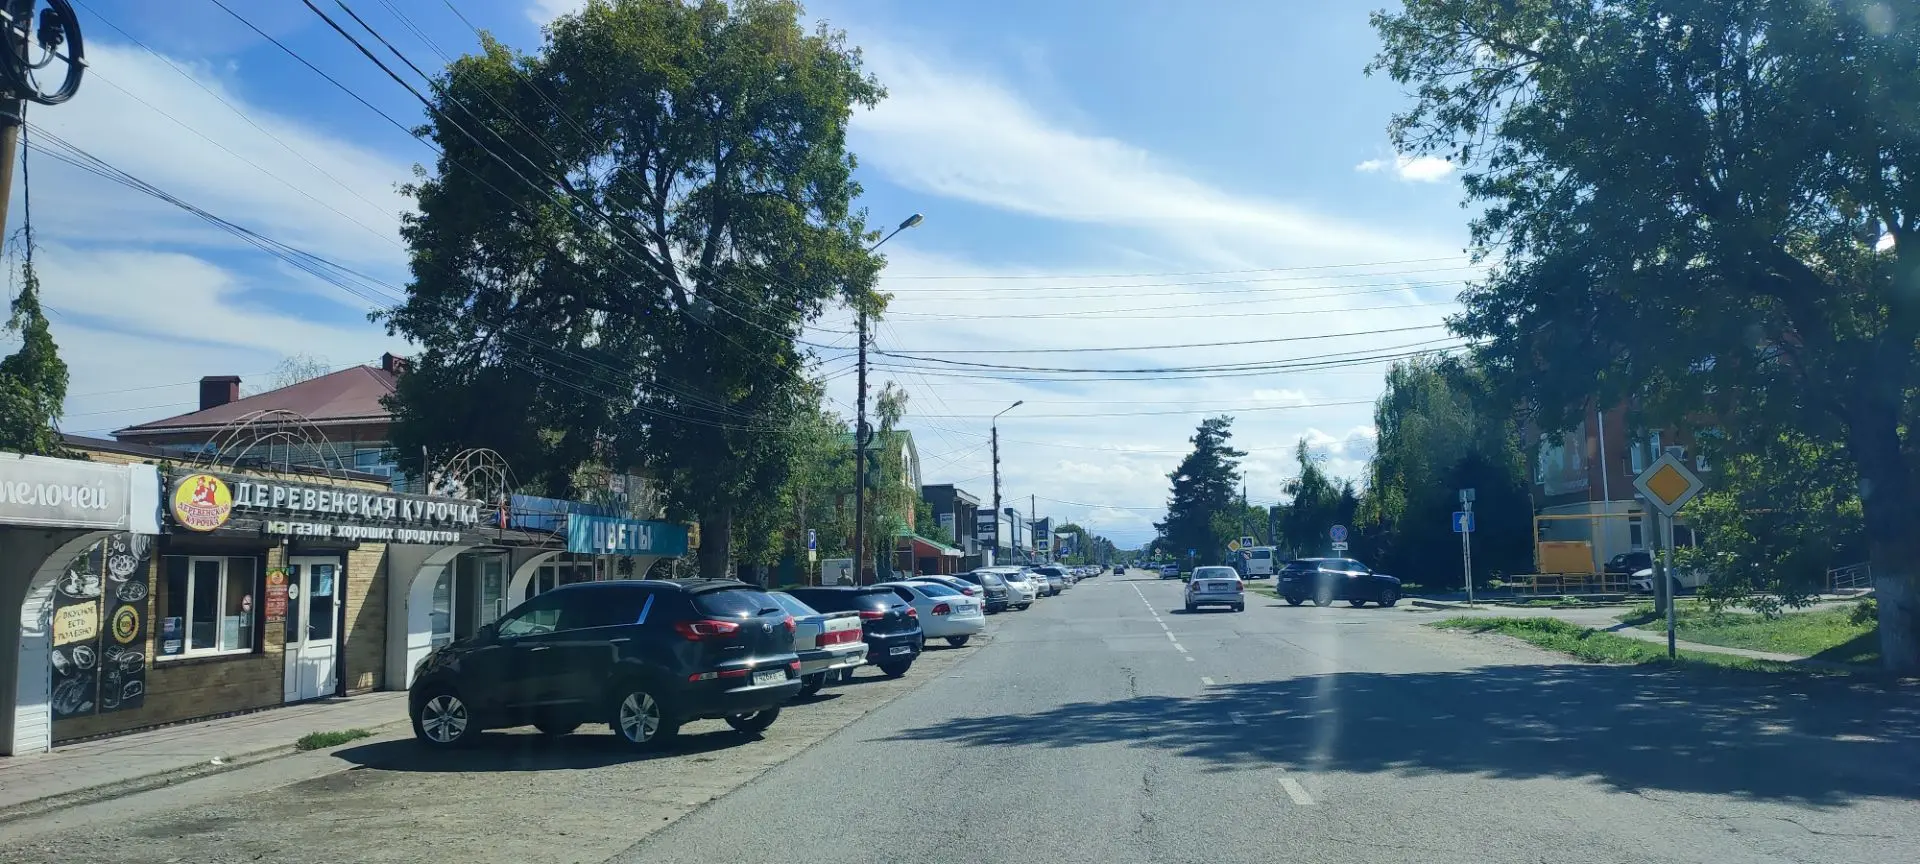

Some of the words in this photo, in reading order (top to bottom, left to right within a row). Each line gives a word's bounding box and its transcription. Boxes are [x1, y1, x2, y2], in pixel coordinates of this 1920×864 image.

[178, 502, 229, 516] ДЕРЕВЕНСКАЯ
[232, 482, 397, 519] ДЕРЕВЕНСКАЯ
[403, 500, 479, 525] КУРОЧКА
[185, 514, 219, 527] КУРОЧКА
[266, 520, 331, 537] магазин
[337, 525, 394, 541] хороших
[398, 529, 460, 544] продуктов
[592, 520, 651, 554] ЦВЕТЫ
